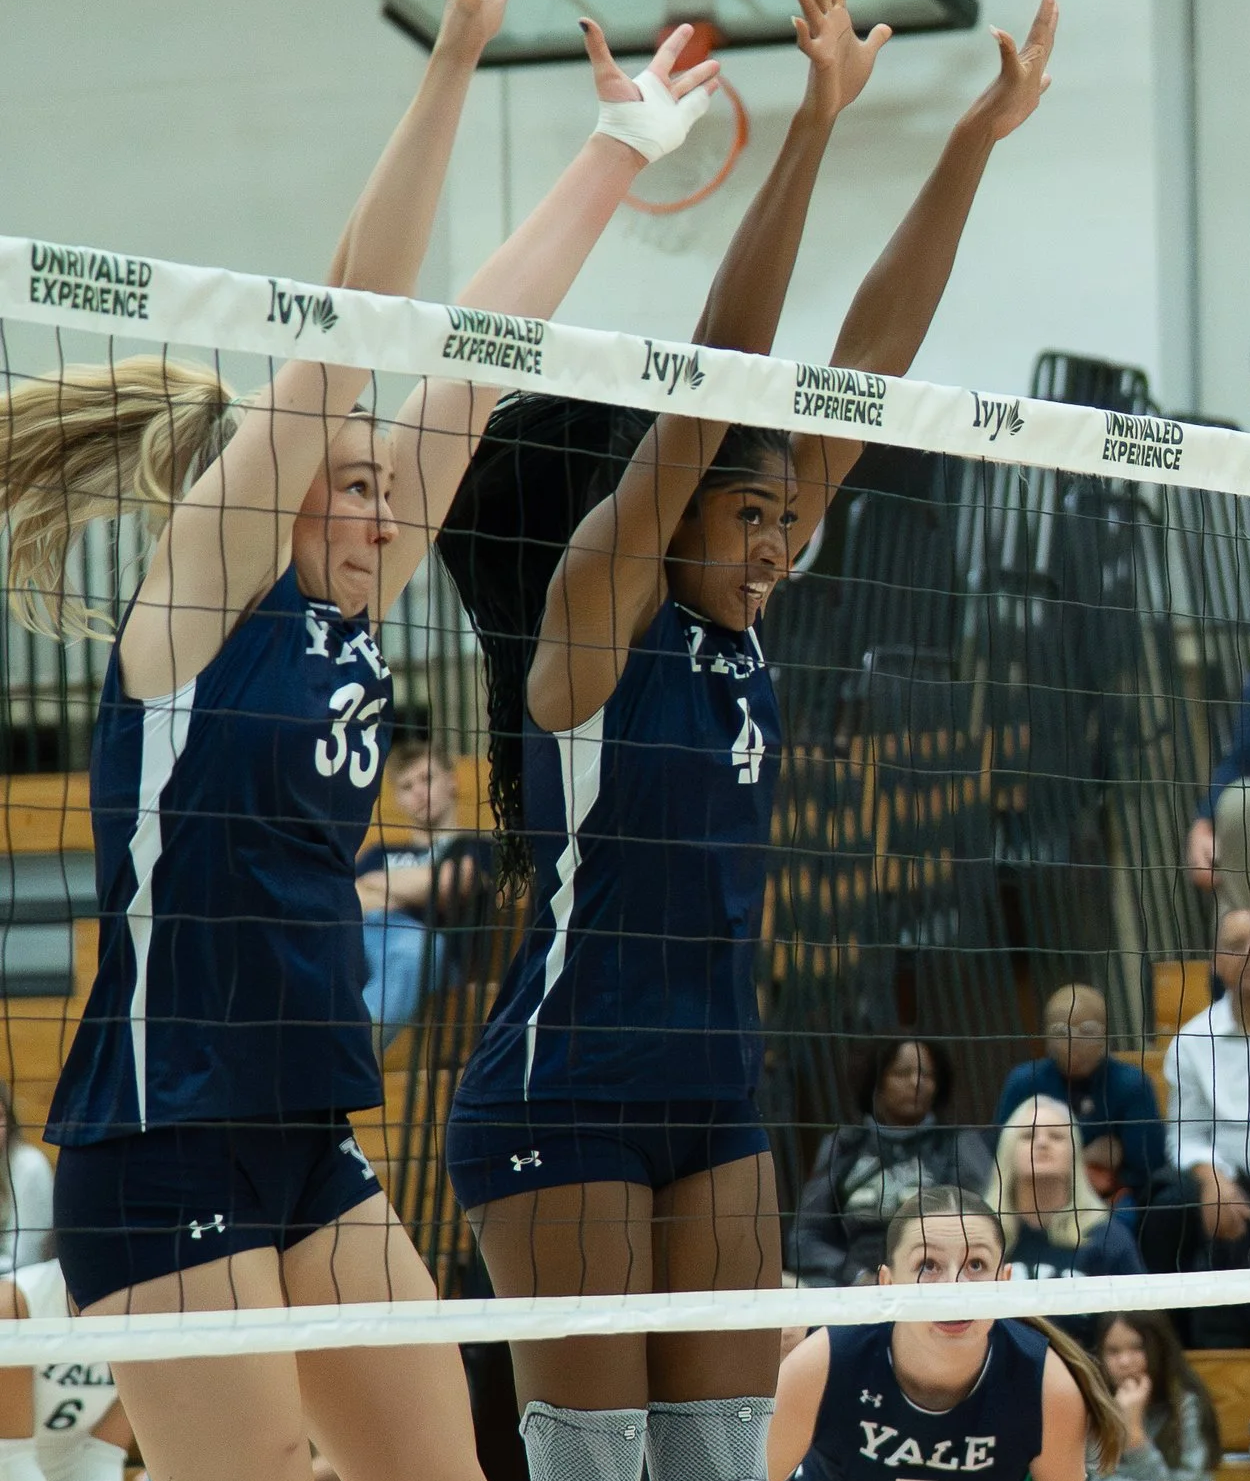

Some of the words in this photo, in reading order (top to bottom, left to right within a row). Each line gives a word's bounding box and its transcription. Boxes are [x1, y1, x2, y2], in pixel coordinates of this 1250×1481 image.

[31, 242, 152, 288] UNRIVALED
[29, 276, 149, 320] EXPERIENCE
[266, 279, 314, 339] Ivy
[446, 305, 544, 346] UNRIVALED
[442, 334, 543, 376] EXPERIENCE
[641, 340, 686, 395] Ivy
[795, 362, 887, 399] UNRIVALED
[794, 391, 884, 427] EXPERIENCE
[969, 391, 1008, 441] Ivy
[1103, 411, 1184, 445] UNRIVALED
[1102, 438, 1183, 470] EXPERIENCE
[305, 609, 392, 680] YE
[314, 681, 388, 789] 33
[42, 1362, 115, 1386] AL
[44, 1399, 84, 1430] 6
[859, 1420, 996, 1471] YALE
